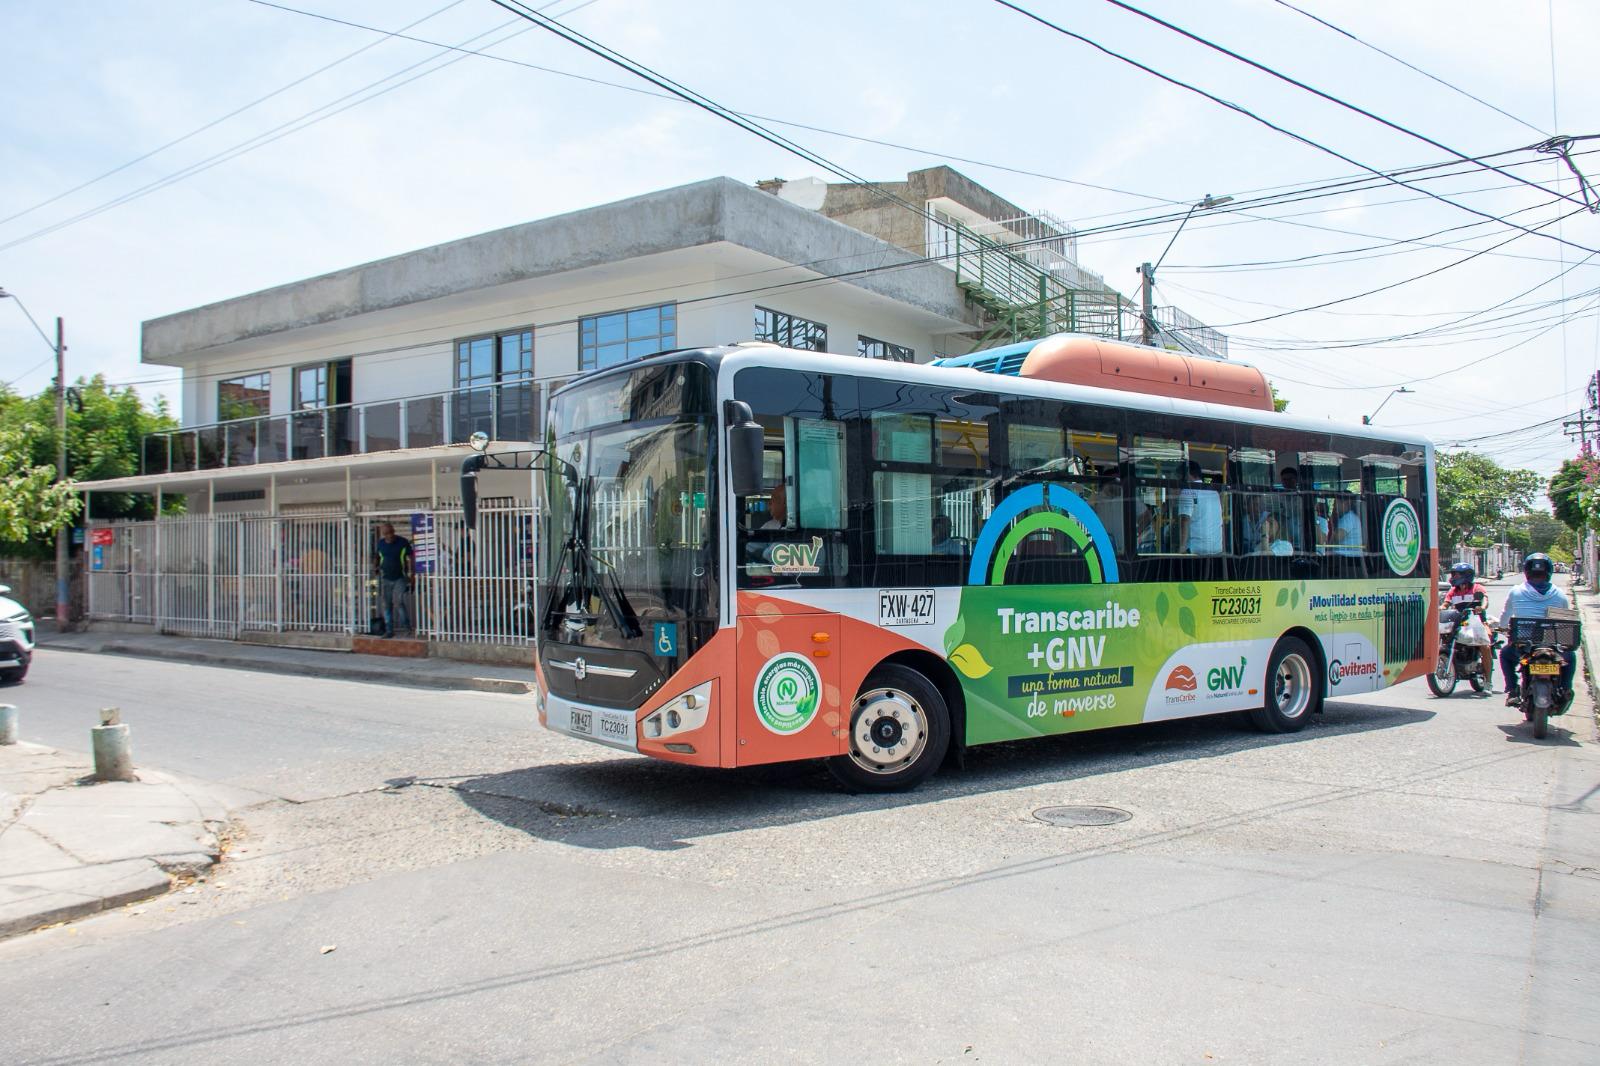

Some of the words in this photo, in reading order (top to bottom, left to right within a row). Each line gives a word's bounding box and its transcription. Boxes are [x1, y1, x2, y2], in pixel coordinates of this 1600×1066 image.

[772, 541, 821, 567] GNV
[1215, 586, 1246, 594] TransCaribe
[1309, 594, 1356, 610] ¡Movilidad
[1358, 592, 1400, 606] sostenible
[998, 600, 1140, 634] Transcaribe
[1212, 598, 1262, 615] TC23031
[1028, 636, 1106, 670] +GNV
[1022, 680, 1044, 692] una
[1048, 671, 1080, 690] forma
[1084, 666, 1122, 686] natural
[1207, 663, 1245, 691] GNV
[1027, 692, 1048, 718] de
[1054, 694, 1116, 715] moverse
[1166, 694, 1196, 704] TransCaribe
[601, 720, 628, 736] TC23031
